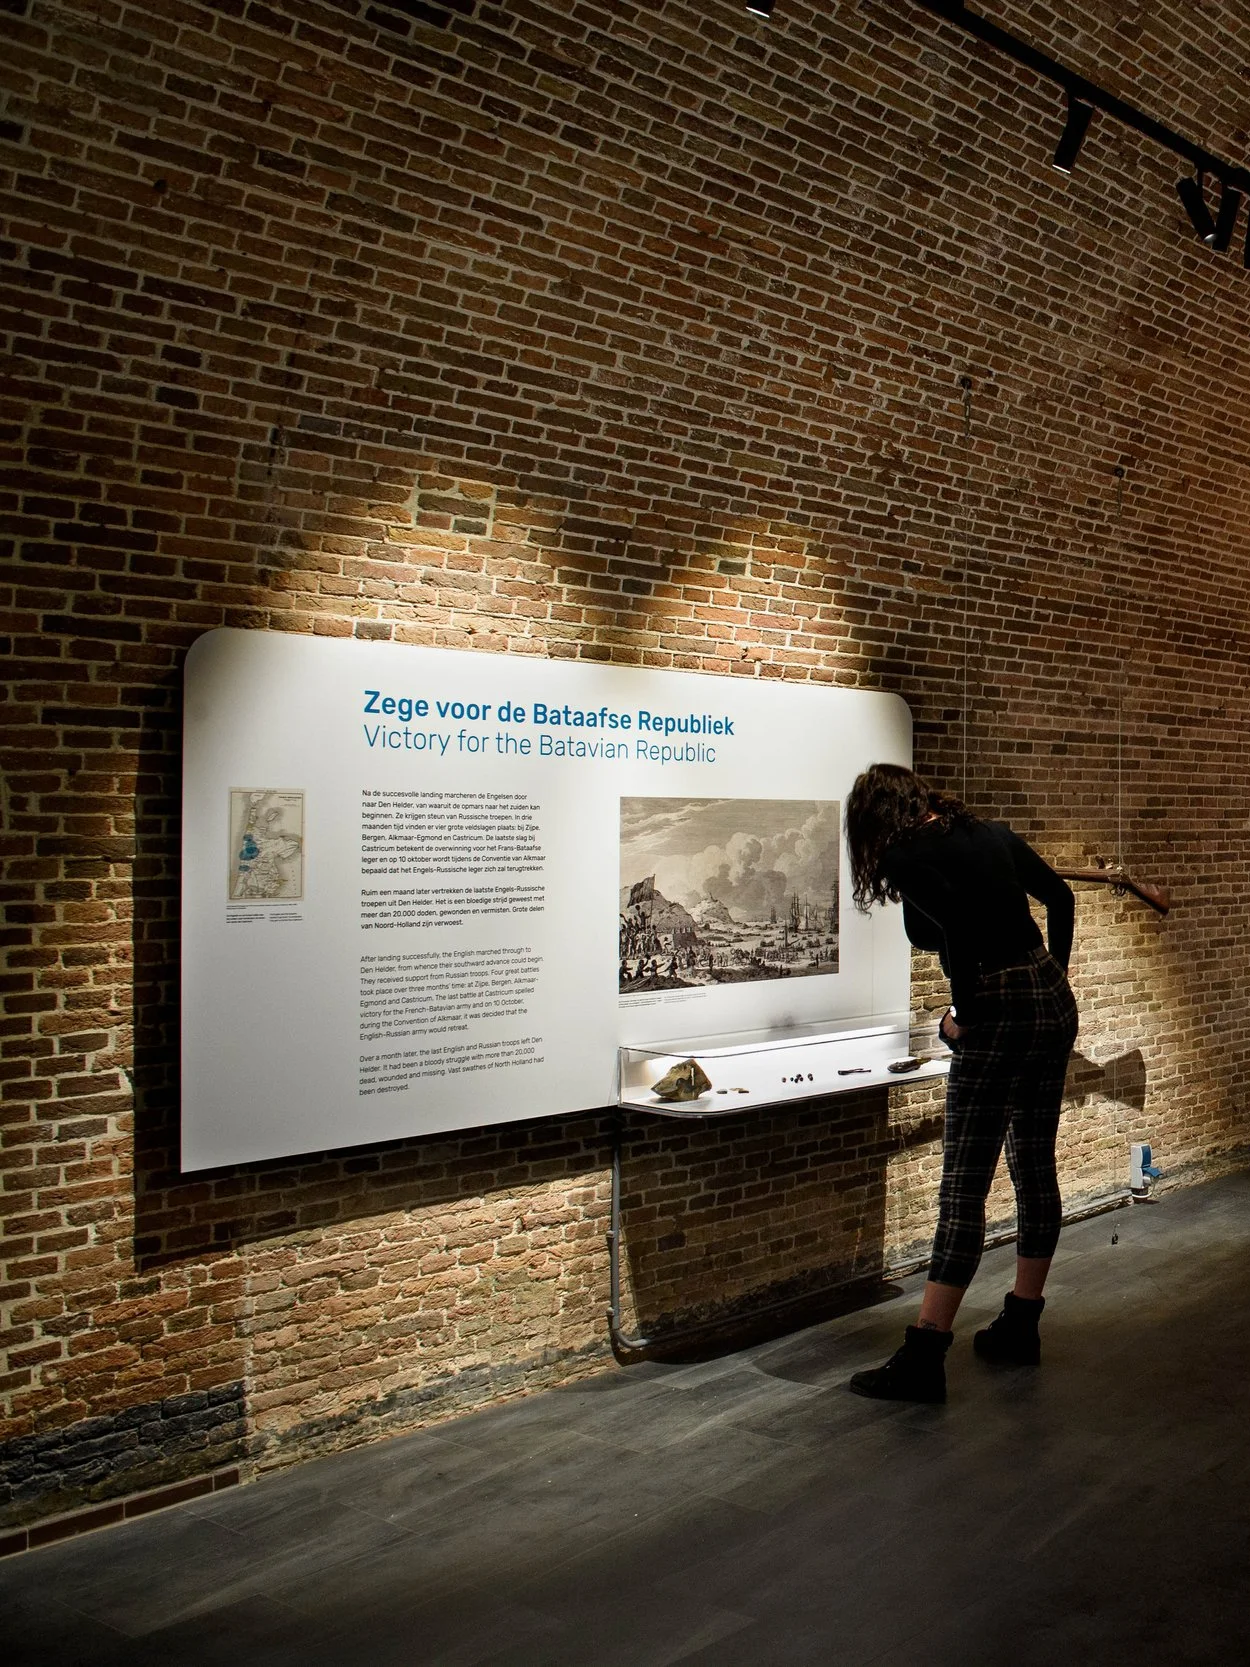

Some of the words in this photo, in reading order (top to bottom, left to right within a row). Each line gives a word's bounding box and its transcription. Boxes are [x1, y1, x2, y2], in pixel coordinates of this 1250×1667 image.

[364, 690, 429, 722] Zege
[436, 700, 491, 720] voor
[497, 701, 526, 723] de
[533, 704, 631, 730] Bataafse
[638, 710, 734, 736] Republiek
[364, 724, 450, 756] Victory
[457, 729, 490, 753] for
[495, 732, 532, 755] the
[540, 735, 628, 759] Batavian
[636, 740, 716, 765] Republic
[487, 793, 513, 801] Engelsen
[413, 866, 467, 874] Engels-Russische
[495, 886, 545, 894] Engels-Russische
